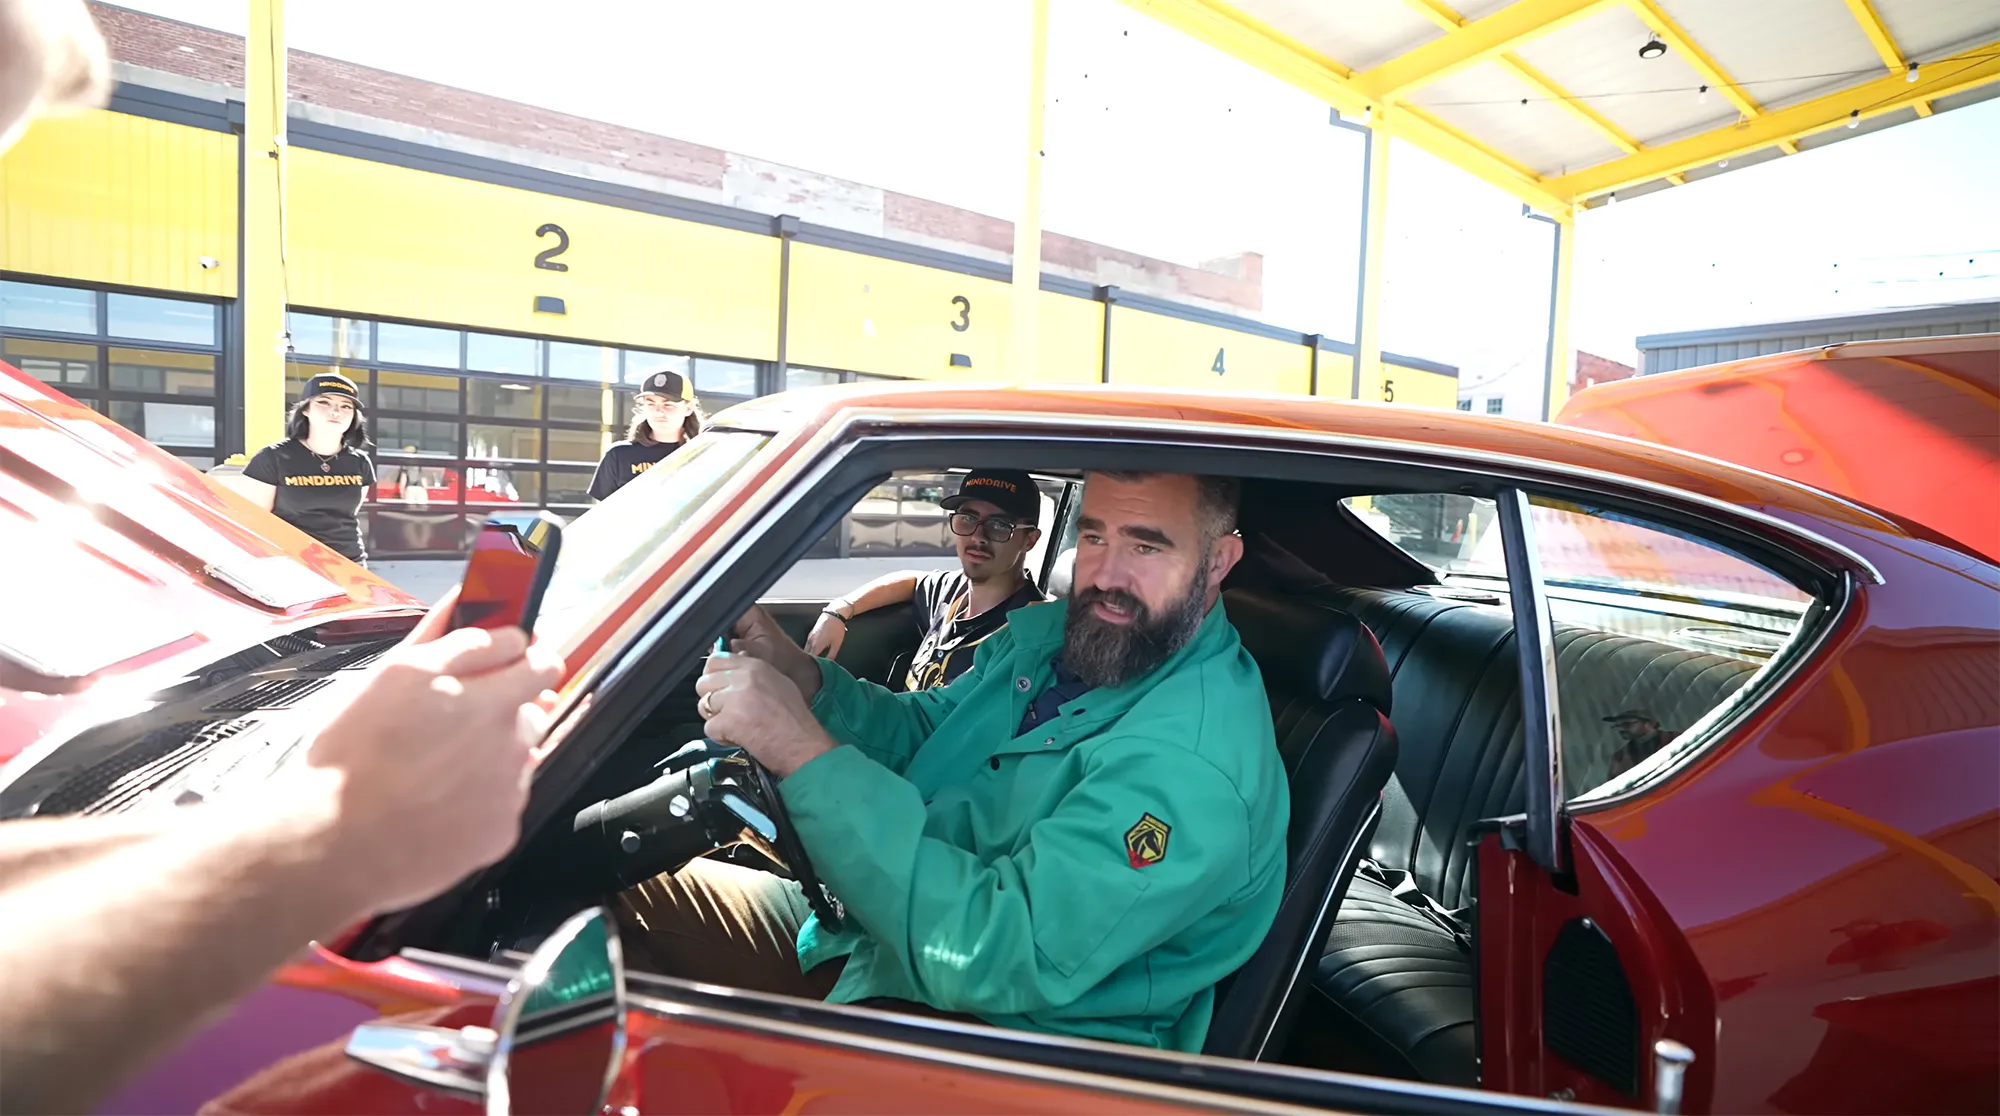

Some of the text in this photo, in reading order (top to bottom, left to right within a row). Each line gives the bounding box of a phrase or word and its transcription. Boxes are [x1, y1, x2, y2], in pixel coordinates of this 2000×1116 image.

[534, 223, 569, 272] 2
[951, 295, 970, 332] 3
[1211, 347, 1225, 376] 4
[319, 381, 355, 393] MINDDRIVE
[1384, 380, 1394, 403] 5
[284, 475, 363, 486] MINDDRIVE
[966, 477, 1018, 493] MINDDRIVE
